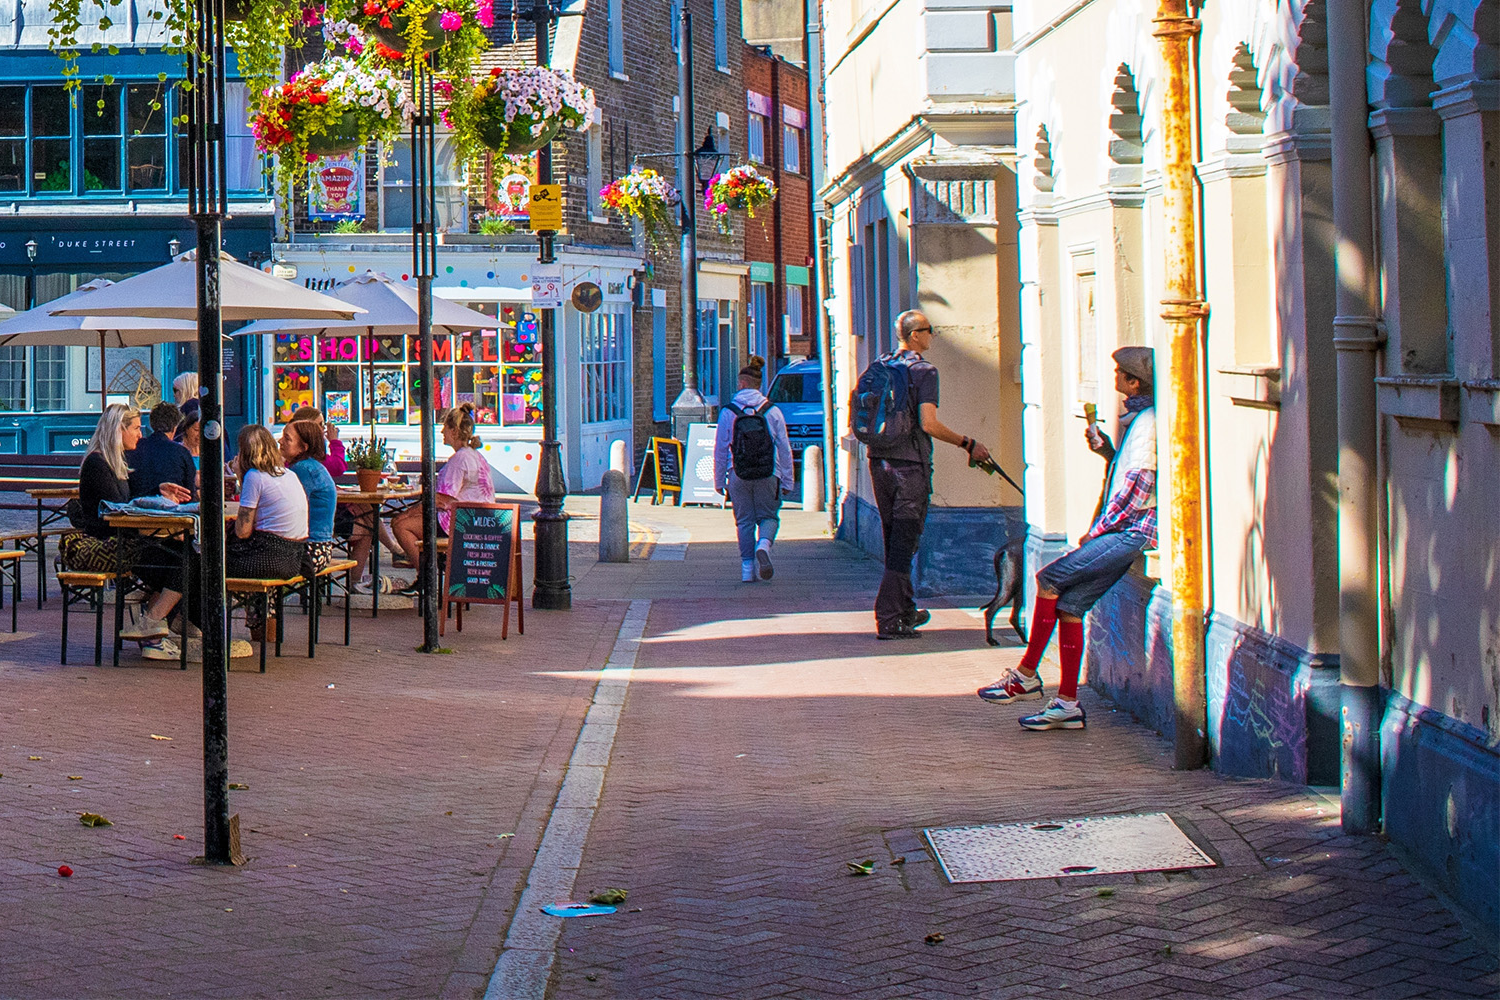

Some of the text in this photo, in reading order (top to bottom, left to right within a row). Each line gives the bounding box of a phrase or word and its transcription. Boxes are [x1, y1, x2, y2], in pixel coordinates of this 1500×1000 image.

[58, 239, 136, 248] DUKE STREET
[305, 278, 341, 291] littl
[299, 337, 380, 360] SHOP
[472, 516, 496, 527] WILDES
